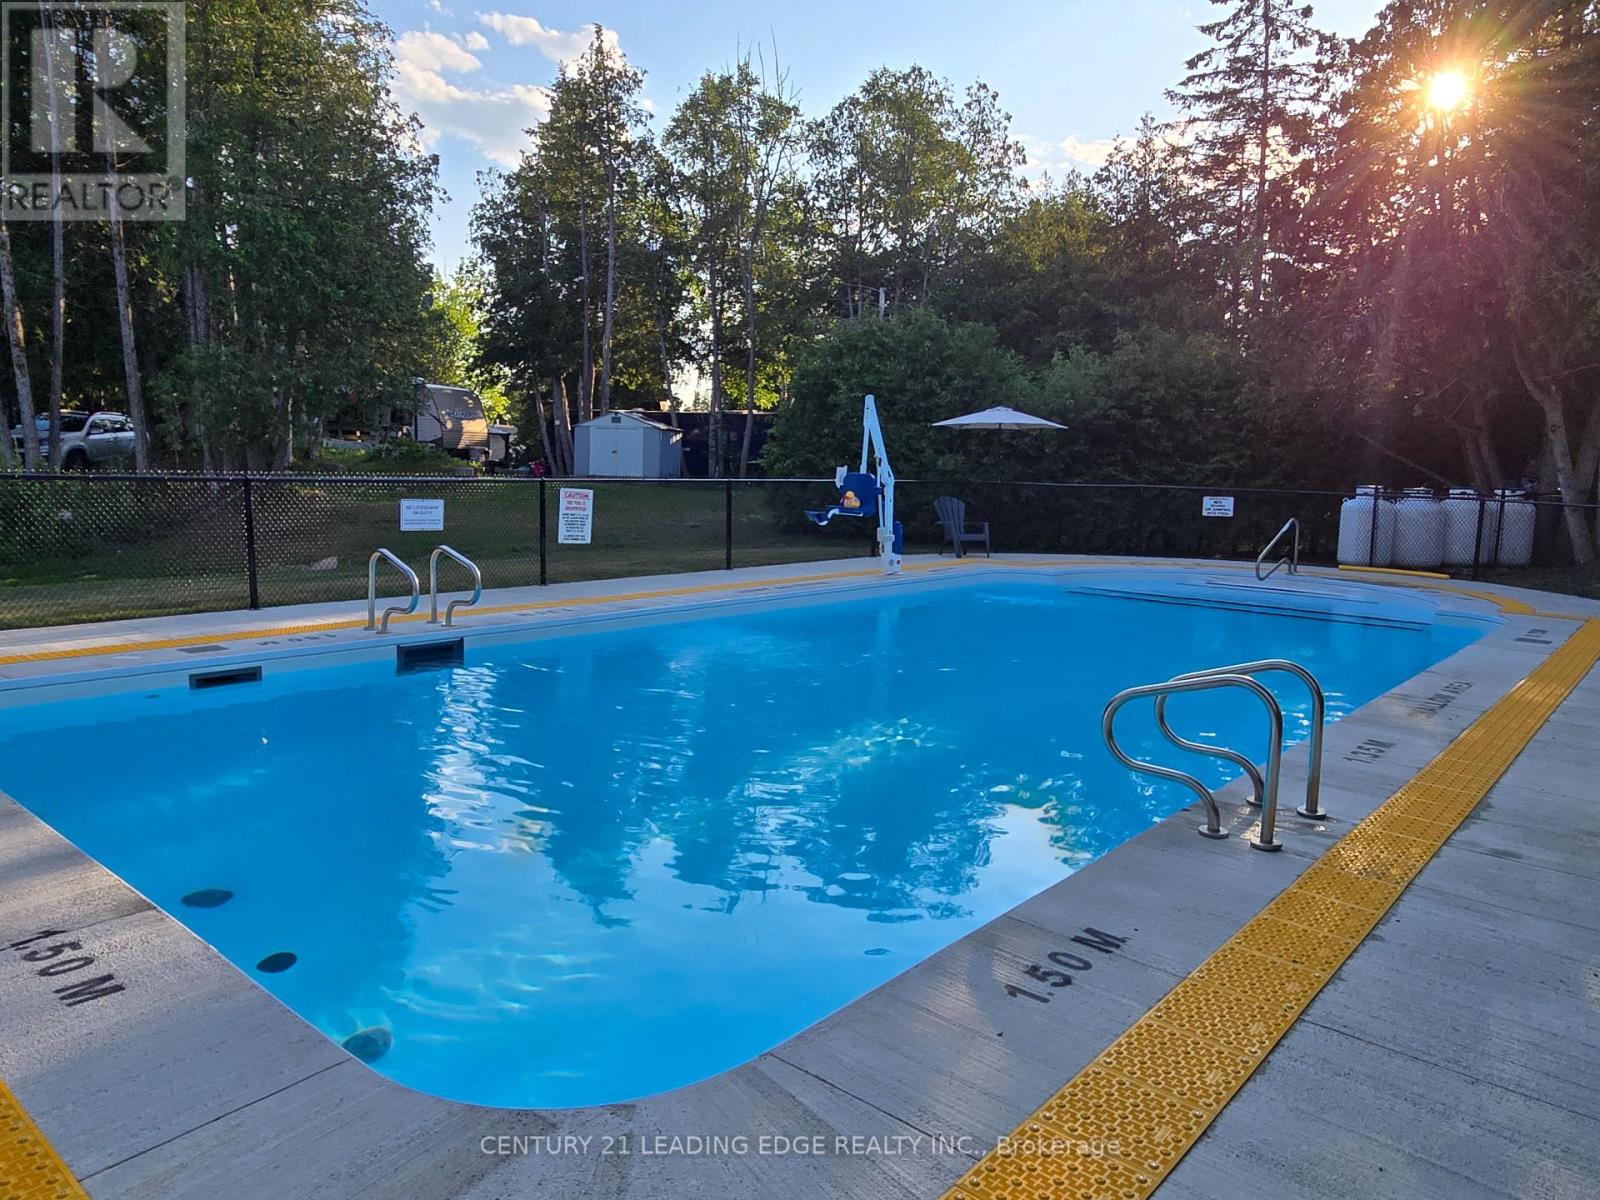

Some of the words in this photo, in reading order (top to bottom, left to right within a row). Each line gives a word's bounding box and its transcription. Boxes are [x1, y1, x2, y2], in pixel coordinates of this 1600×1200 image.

[52, 972, 126, 1008] M
[1004, 951, 1093, 1004] 1.50
[1070, 927, 1128, 954] M
